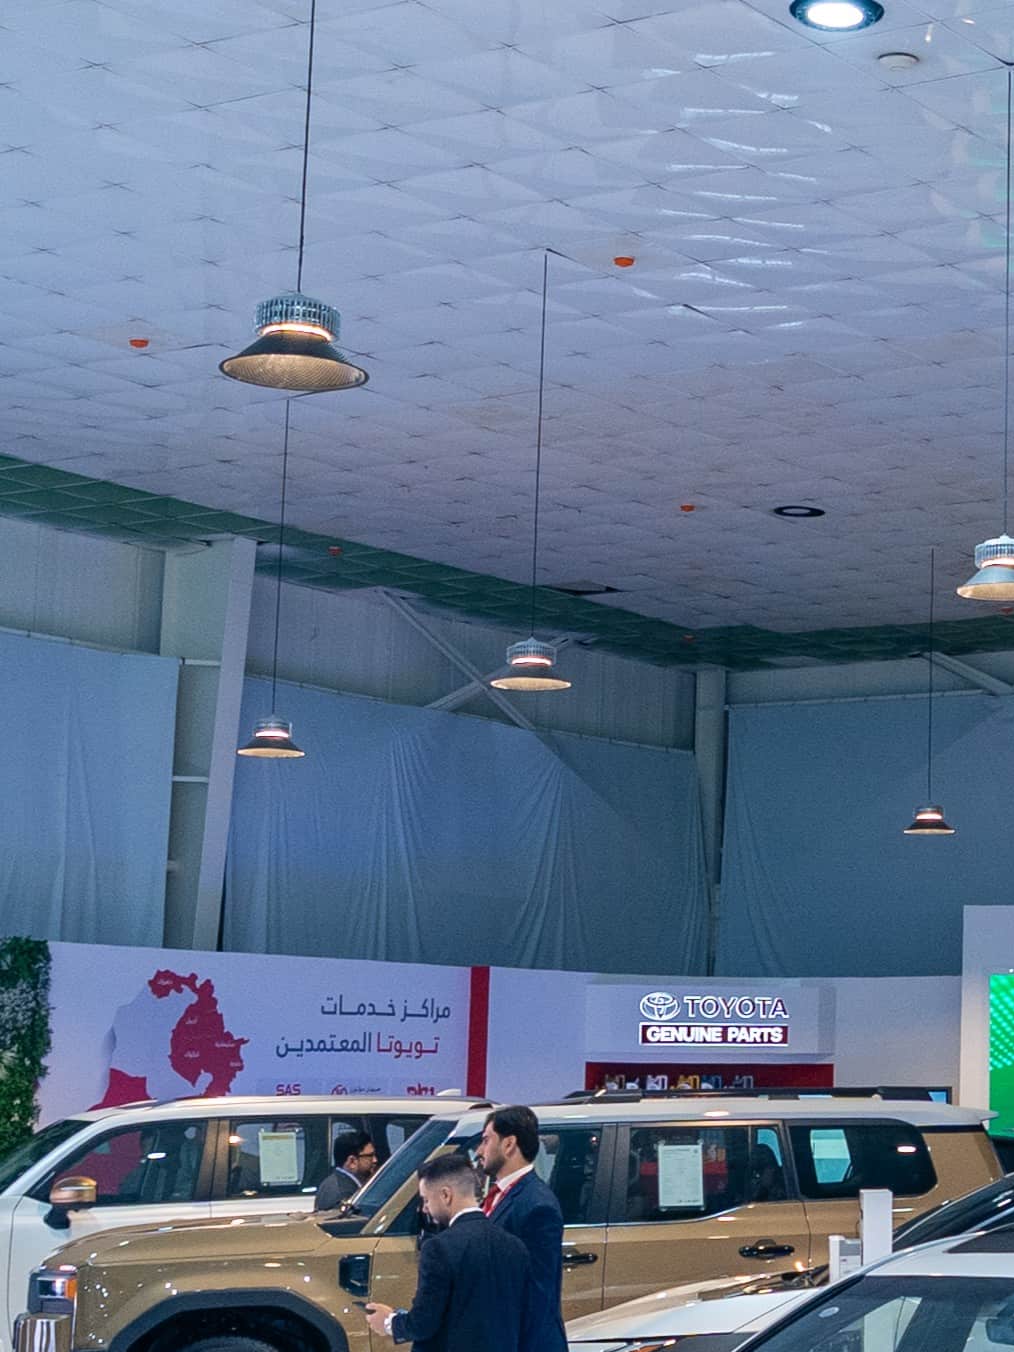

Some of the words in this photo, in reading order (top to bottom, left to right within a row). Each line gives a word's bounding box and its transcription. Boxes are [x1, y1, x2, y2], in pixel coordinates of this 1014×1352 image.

[321, 994, 396, 1017] خدمات
[400, 998, 451, 1023] مراكز
[683, 995, 790, 1018] TOYOTA
[276, 1031, 372, 1059] المعتمدين
[376, 1031, 440, 1059] تويوتا
[646, 1026, 722, 1042] GENUINE
[728, 1026, 782, 1042] PARTS
